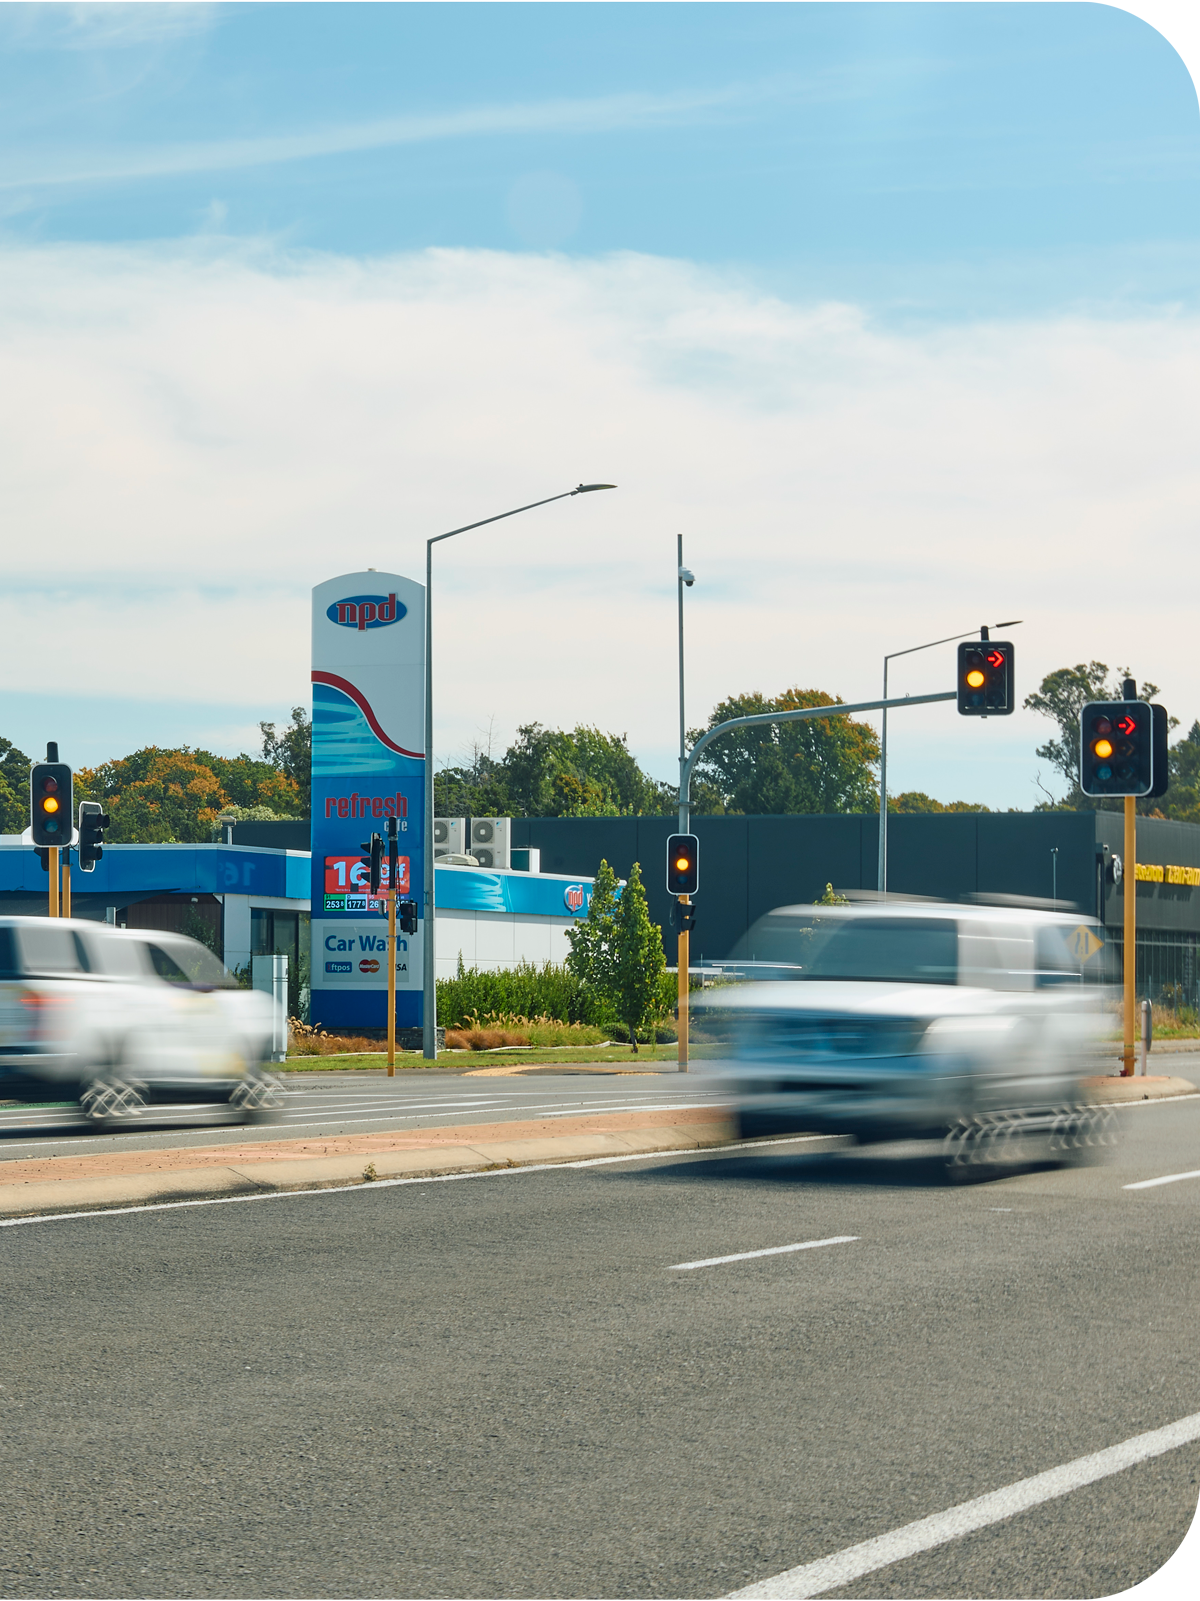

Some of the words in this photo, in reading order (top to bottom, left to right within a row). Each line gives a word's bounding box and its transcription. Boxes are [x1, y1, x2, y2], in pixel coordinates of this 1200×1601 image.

[336, 593, 396, 631] npd
[325, 792, 408, 818] refresh
[384, 818, 407, 832] cfé
[568, 885, 583, 911] npd
[325, 935, 356, 952] Car
[358, 935, 408, 952] Wah
